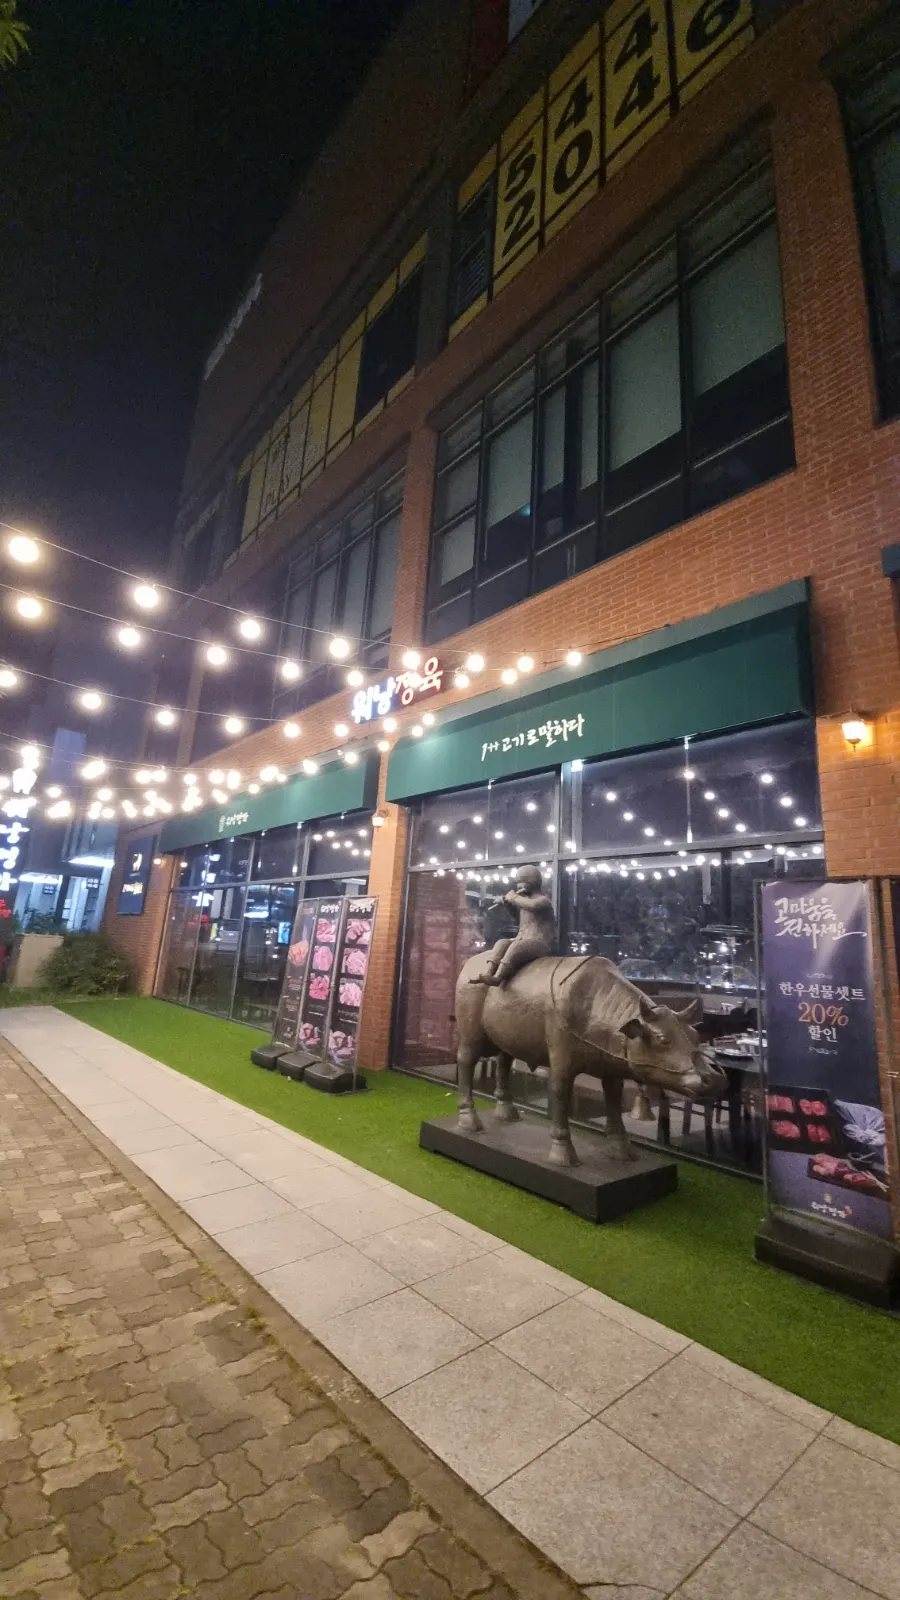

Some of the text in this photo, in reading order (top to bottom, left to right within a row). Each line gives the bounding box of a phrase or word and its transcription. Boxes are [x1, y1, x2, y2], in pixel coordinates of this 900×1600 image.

[774, 896, 837, 924] 고마움을
[797, 1001, 850, 1027] 20%
[807, 1025, 839, 1043] 할인
